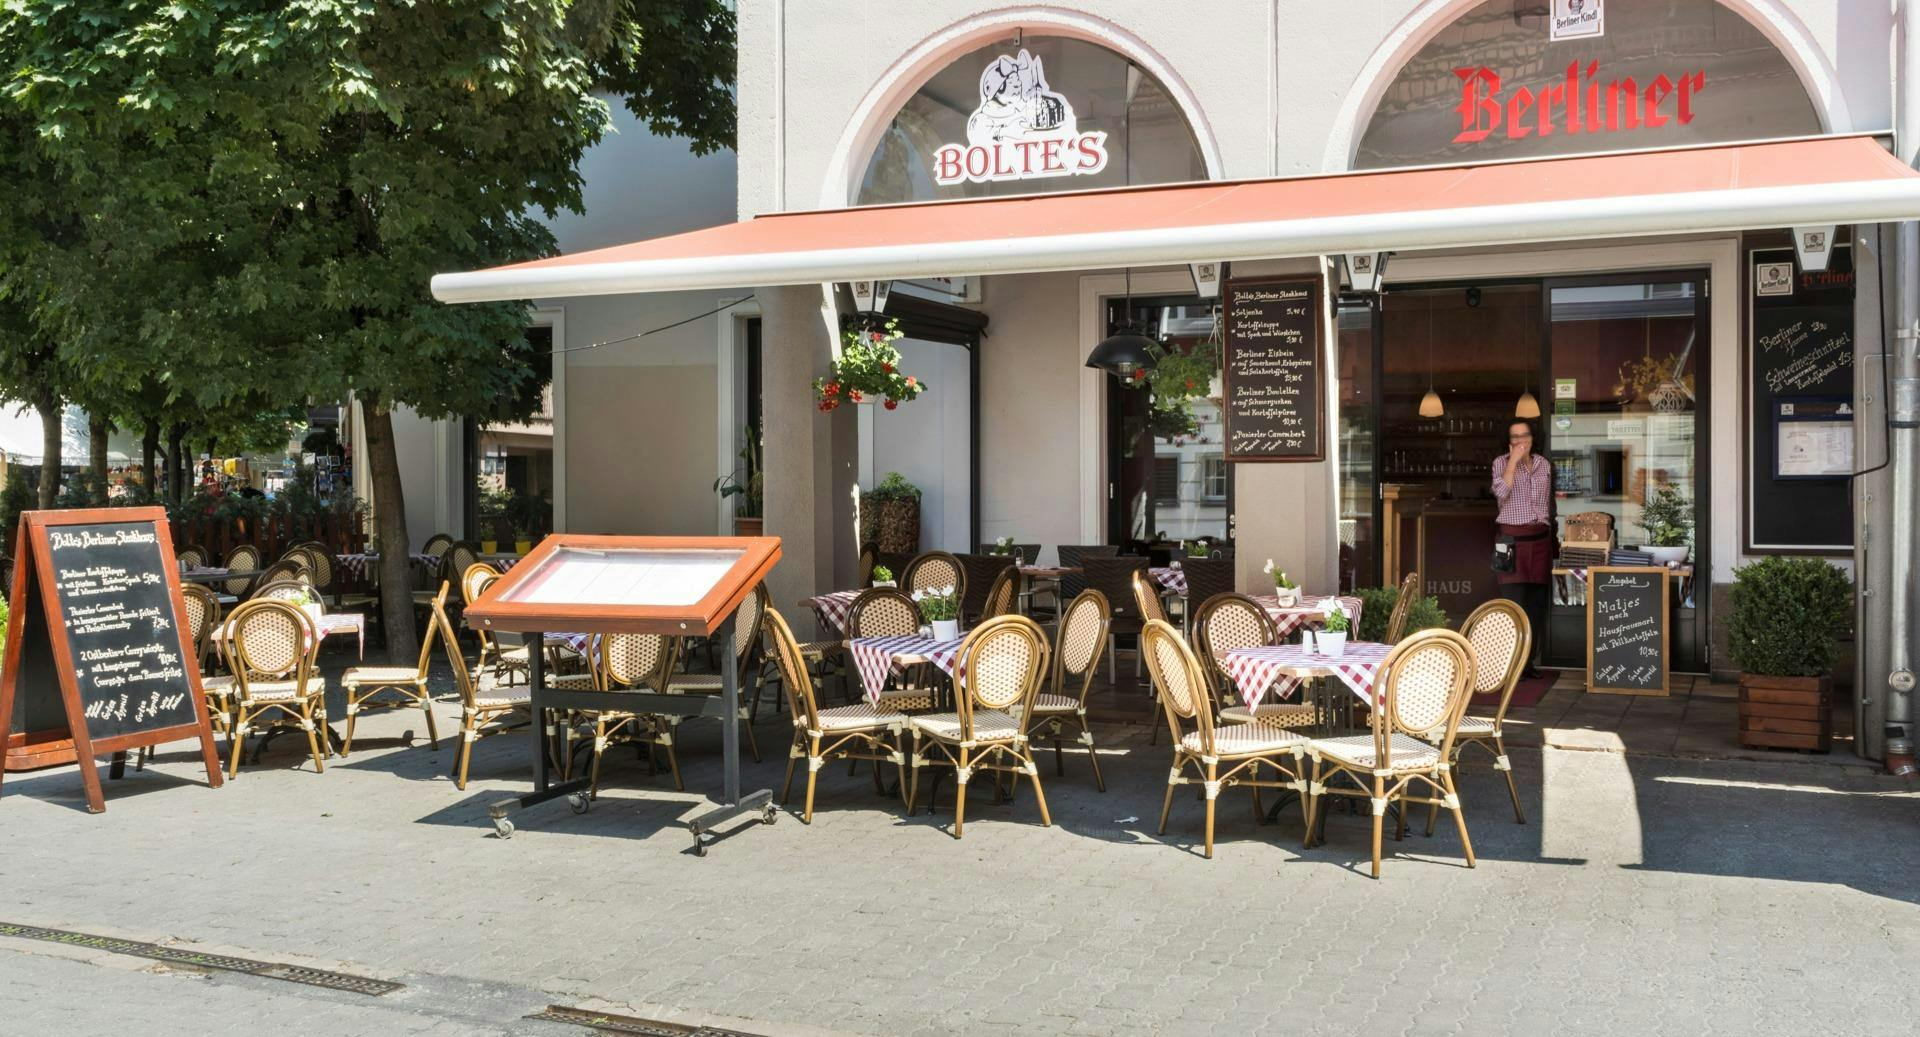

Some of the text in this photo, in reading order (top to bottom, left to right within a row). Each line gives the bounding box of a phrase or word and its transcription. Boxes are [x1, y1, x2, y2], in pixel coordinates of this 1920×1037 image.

[1556, 9, 1598, 29] Berliner Kindl
[1451, 57, 1705, 144] Berliner
[939, 136, 1103, 180] BOLTE'S
[1254, 291, 1279, 300] Berliner
[1237, 321, 1279, 331] Kartoffelsuppe
[1760, 321, 1802, 352] Berliner
[1236, 349, 1294, 359] Berliner Eisbein
[1238, 360, 1248, 370] auf
[1765, 331, 1851, 391] Schweineschnitzel
[1237, 386, 1300, 397] Berliner Bouletten
[1238, 399, 1248, 408] auf
[1236, 429, 1306, 439] Panierter Camembert
[80, 531, 117, 549] Berliner
[60, 569, 86, 580] Berliner
[1608, 575, 1637, 586] Angebot
[1427, 580, 1472, 594] HAUS
[1598, 597, 1640, 613] Matjes
[1609, 610, 1629, 621] nach
[1596, 642, 1608, 653] mit
[80, 651, 87, 661] 2
